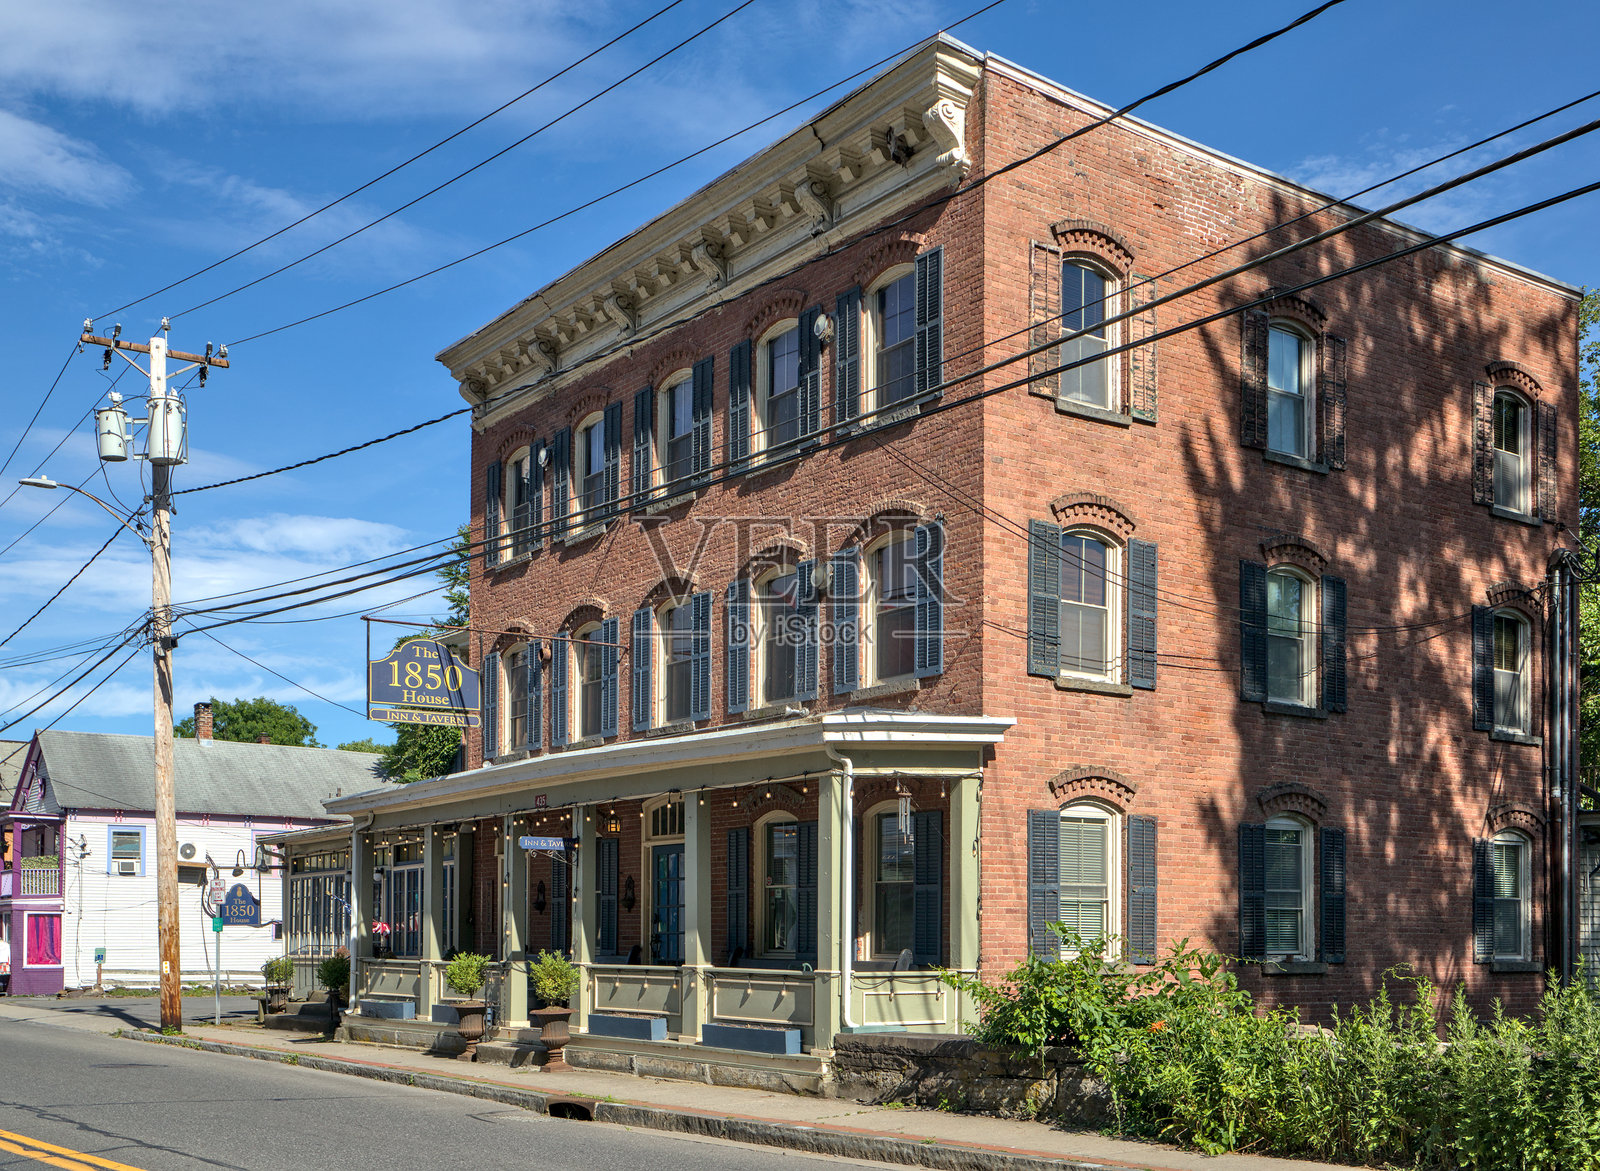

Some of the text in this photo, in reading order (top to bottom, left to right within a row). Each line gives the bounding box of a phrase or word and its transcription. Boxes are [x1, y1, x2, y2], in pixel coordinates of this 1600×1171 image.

[412, 646, 439, 659] The
[389, 660, 463, 692] 1850
[402, 690, 450, 705] House
[386, 711, 465, 725] INN & TAVERN
[536, 796, 545, 806] 435
[225, 905, 255, 916] 1850
